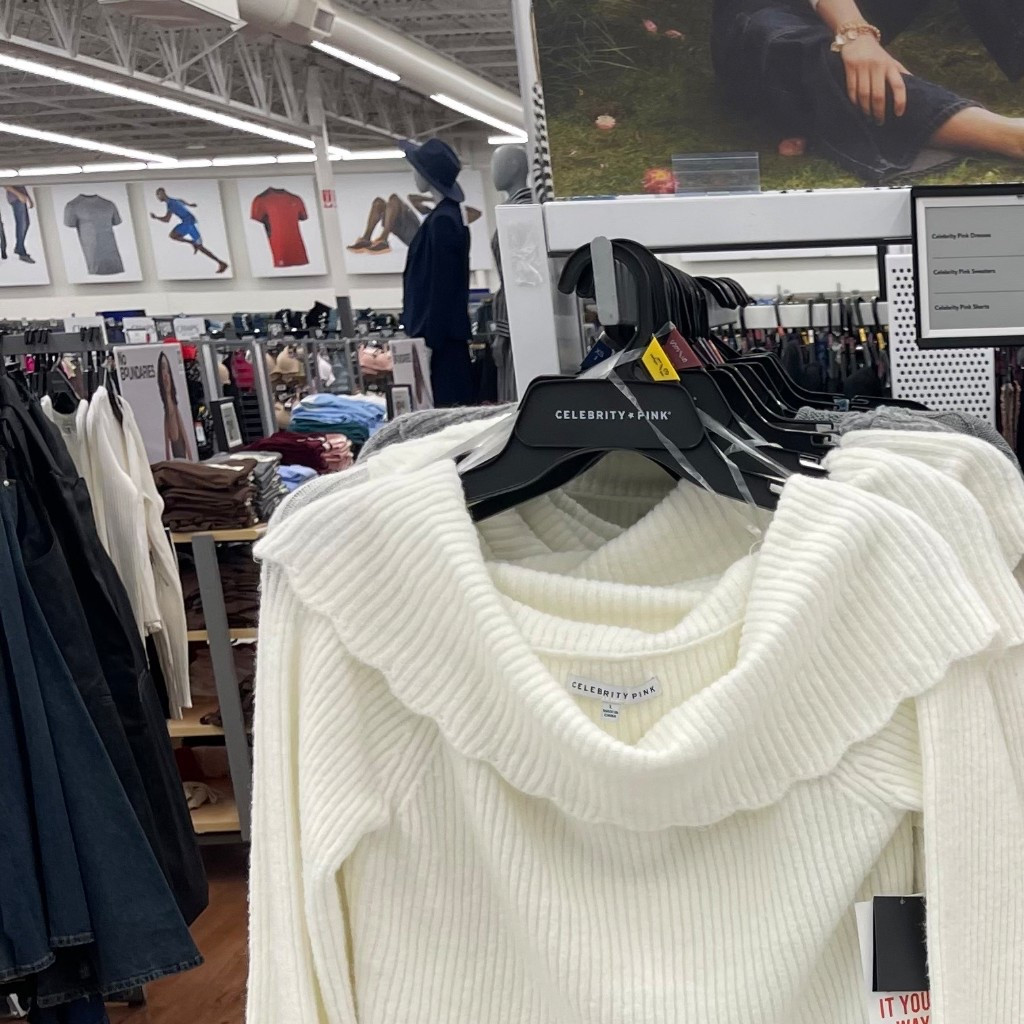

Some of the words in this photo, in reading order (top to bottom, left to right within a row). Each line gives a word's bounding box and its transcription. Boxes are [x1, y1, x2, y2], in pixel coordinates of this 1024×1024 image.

[555, 410, 625, 420] CELEBRITY
[571, 681, 628, 699] CELEBRITY
[631, 685, 656, 700] PINK
[879, 997, 894, 1019] IT
